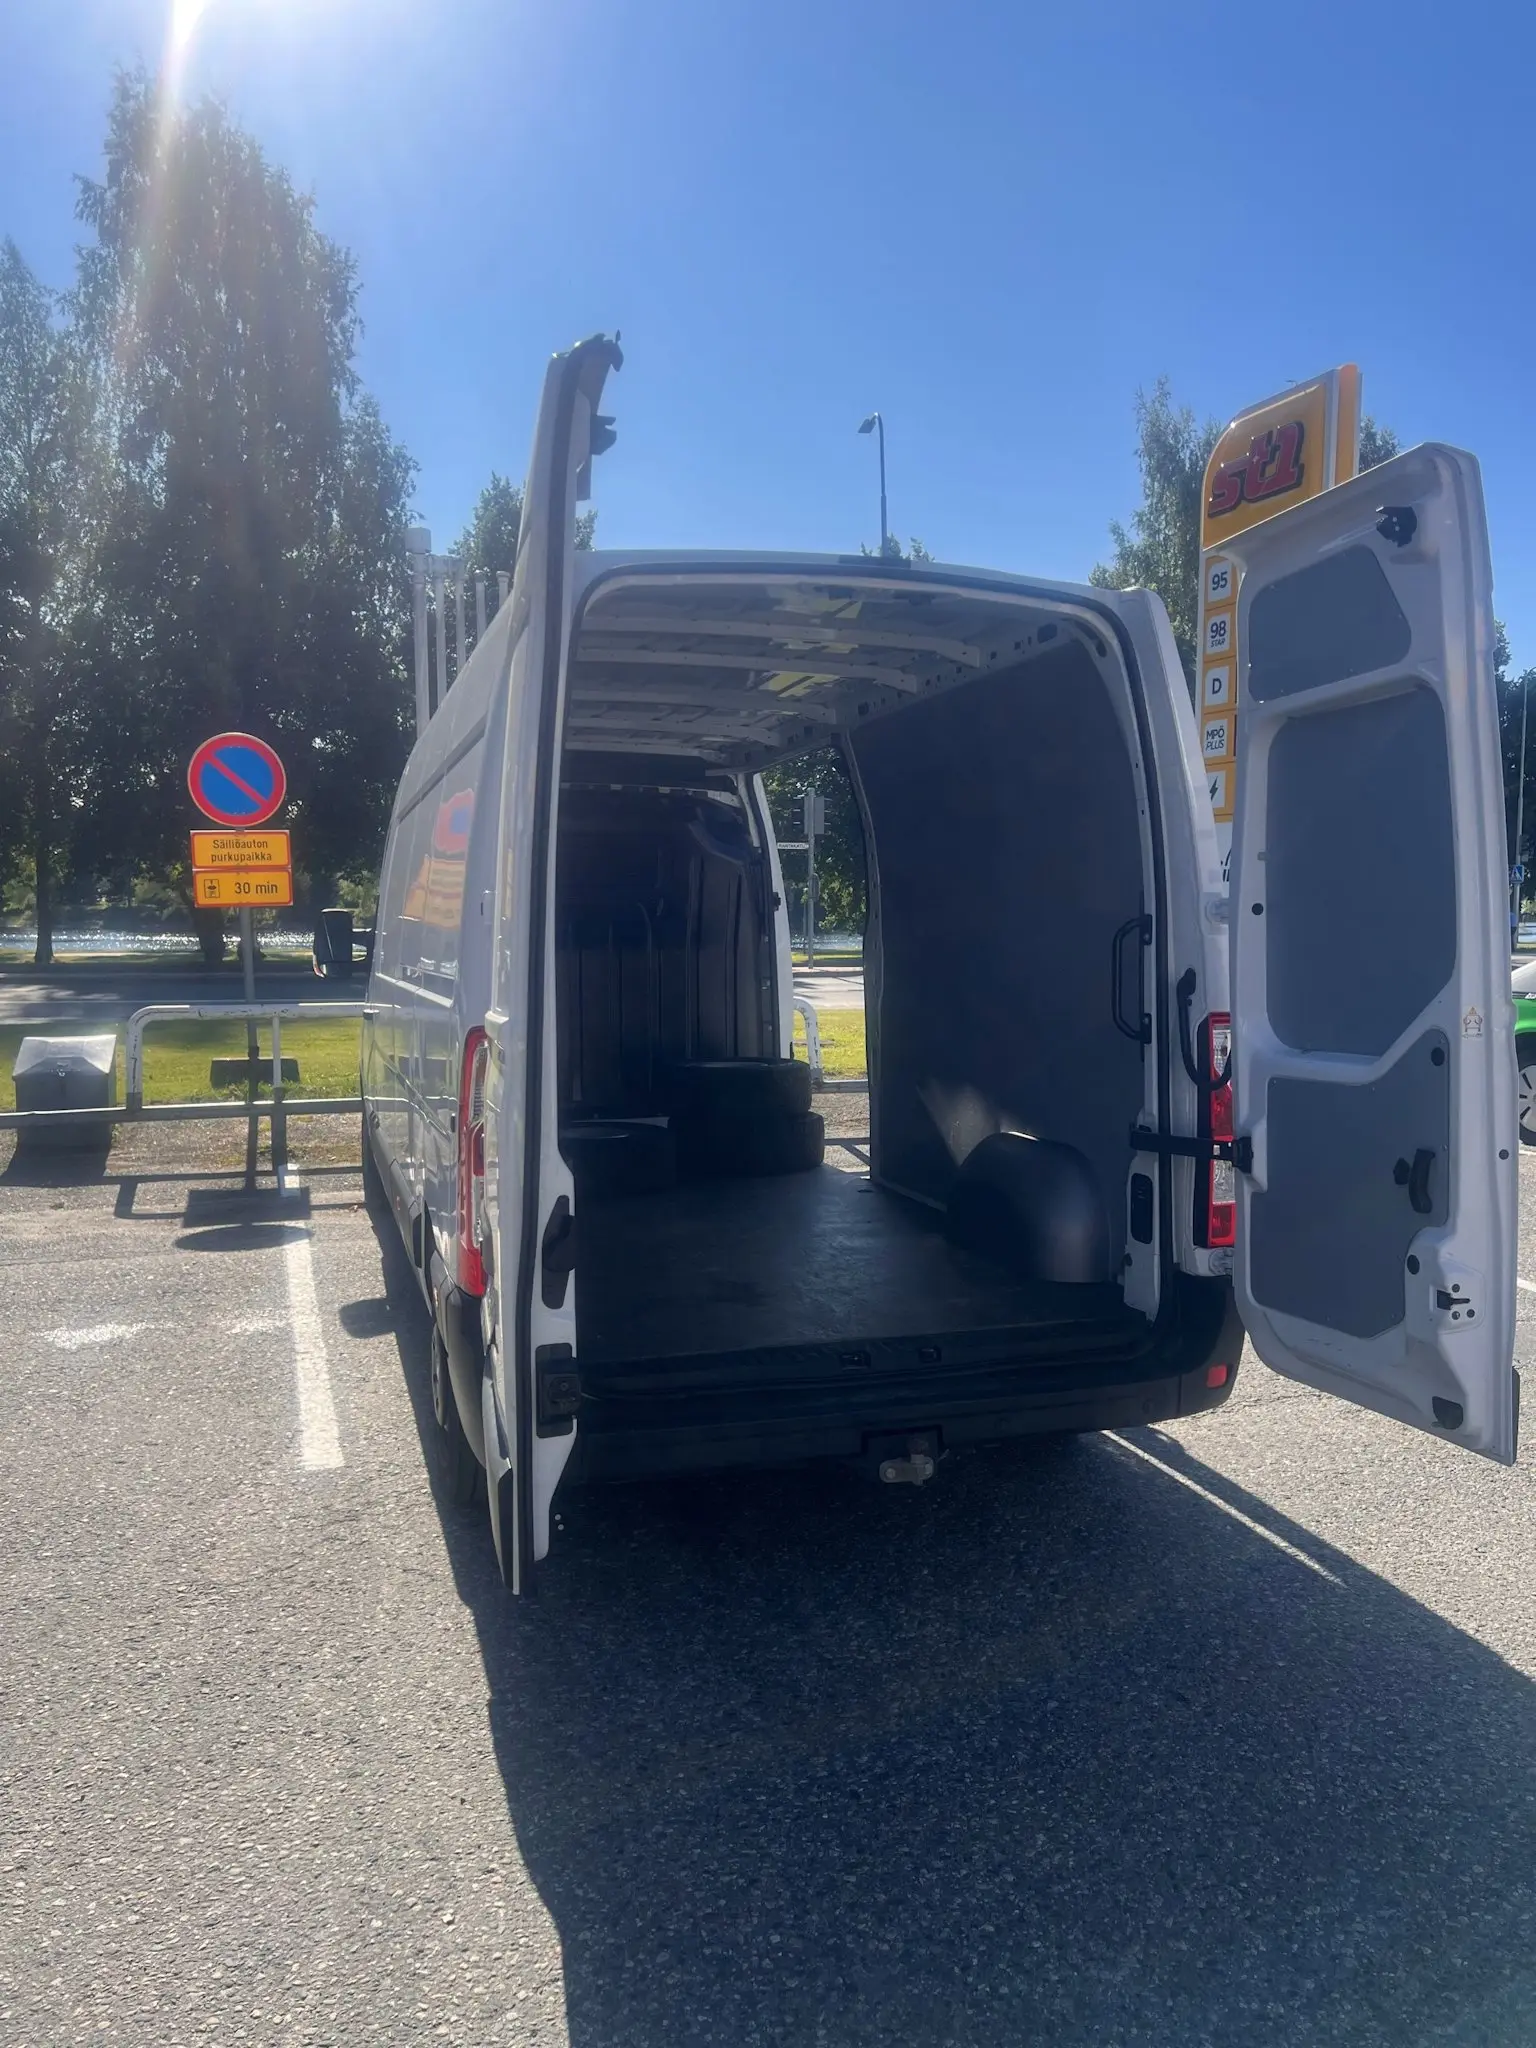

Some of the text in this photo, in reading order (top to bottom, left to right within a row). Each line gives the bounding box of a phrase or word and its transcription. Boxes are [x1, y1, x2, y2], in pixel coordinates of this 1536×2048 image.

[1211, 571, 1228, 591] 95
[1210, 620, 1227, 639] 98
[1212, 678, 1222, 694] D
[1206, 725, 1225, 740] MPÖ
[1206, 739, 1225, 751] PLUS
[212, 839, 268, 849] Säiliöauton
[211, 852, 272, 863] purkupaikka
[234, 881, 278, 894] 30 min
